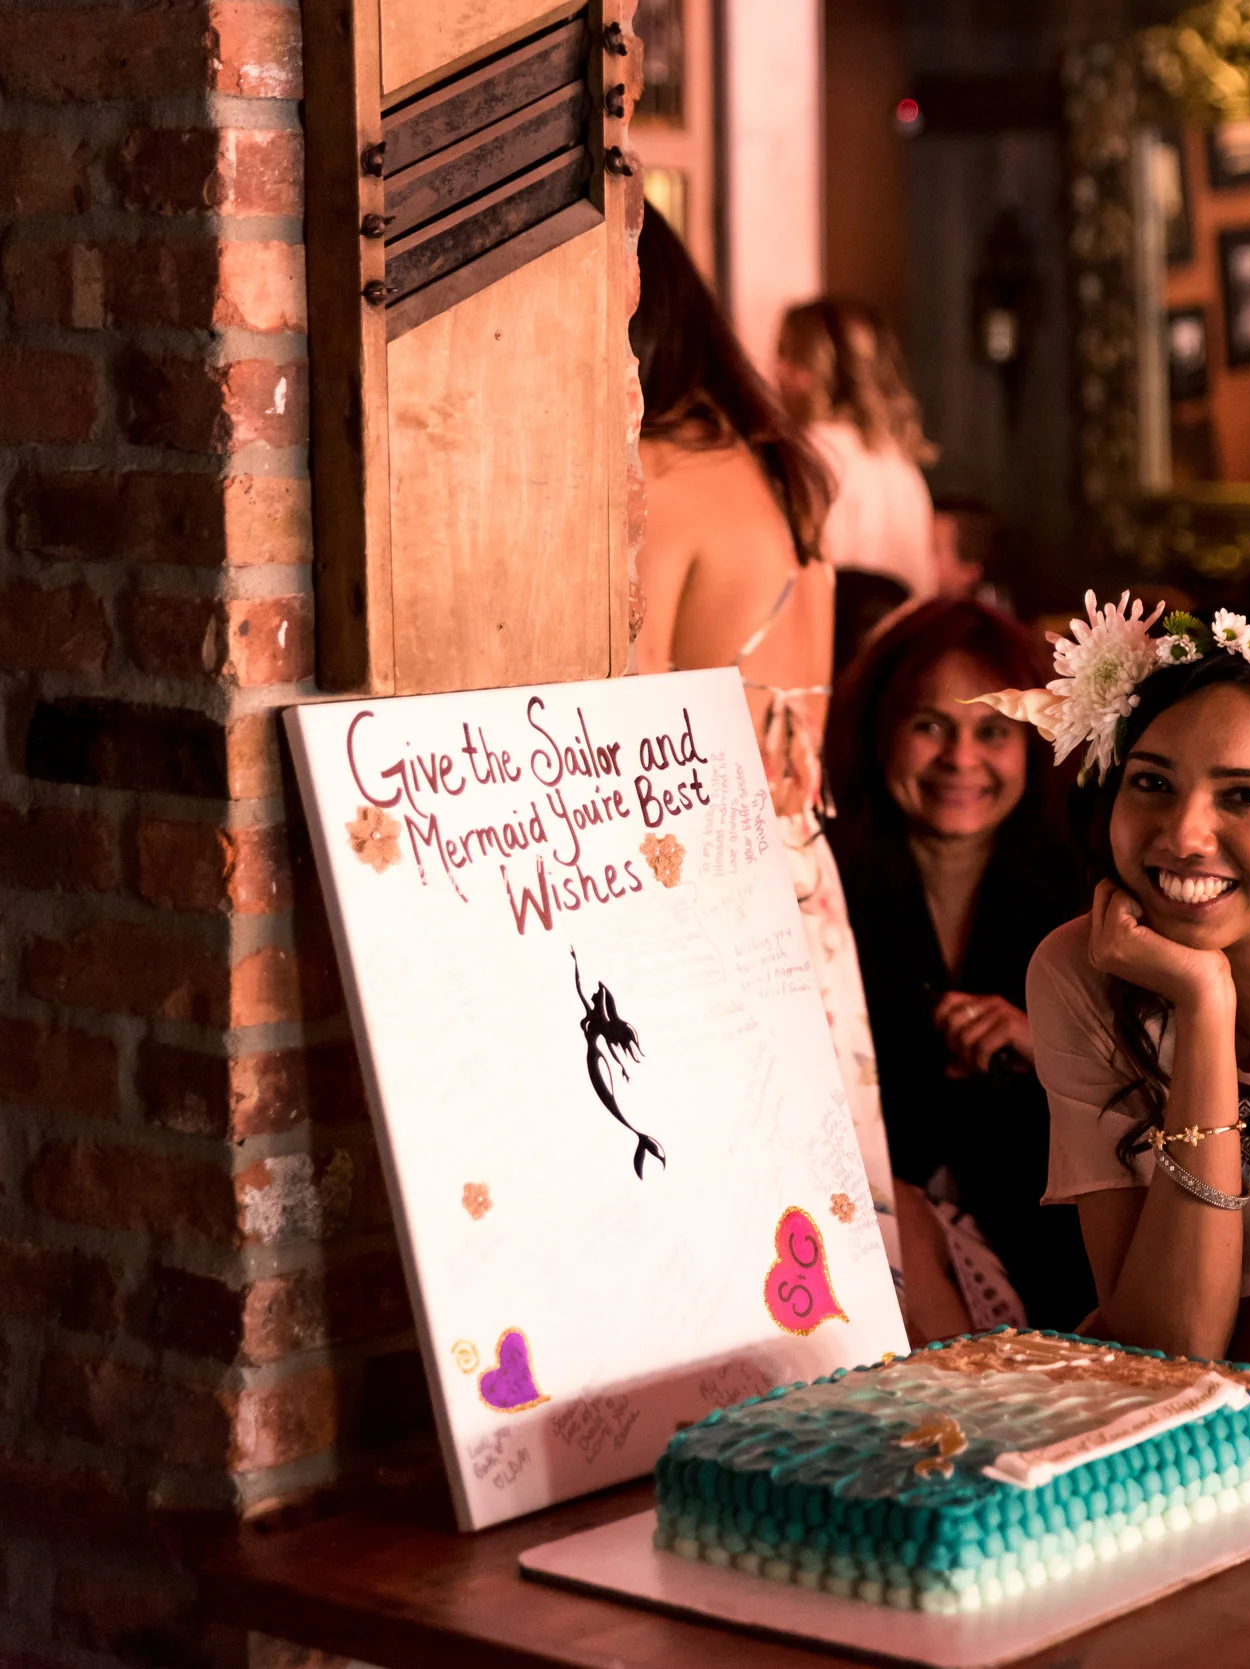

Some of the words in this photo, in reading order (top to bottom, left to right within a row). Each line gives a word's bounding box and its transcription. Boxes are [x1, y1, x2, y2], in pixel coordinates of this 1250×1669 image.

[346, 710, 466, 819] Give
[462, 722, 521, 787] the
[527, 696, 622, 787] Sailor
[639, 708, 708, 771] and
[403, 801, 549, 903] Mermaid
[635, 769, 710, 828] Best
[500, 854, 643, 936] Wishes
